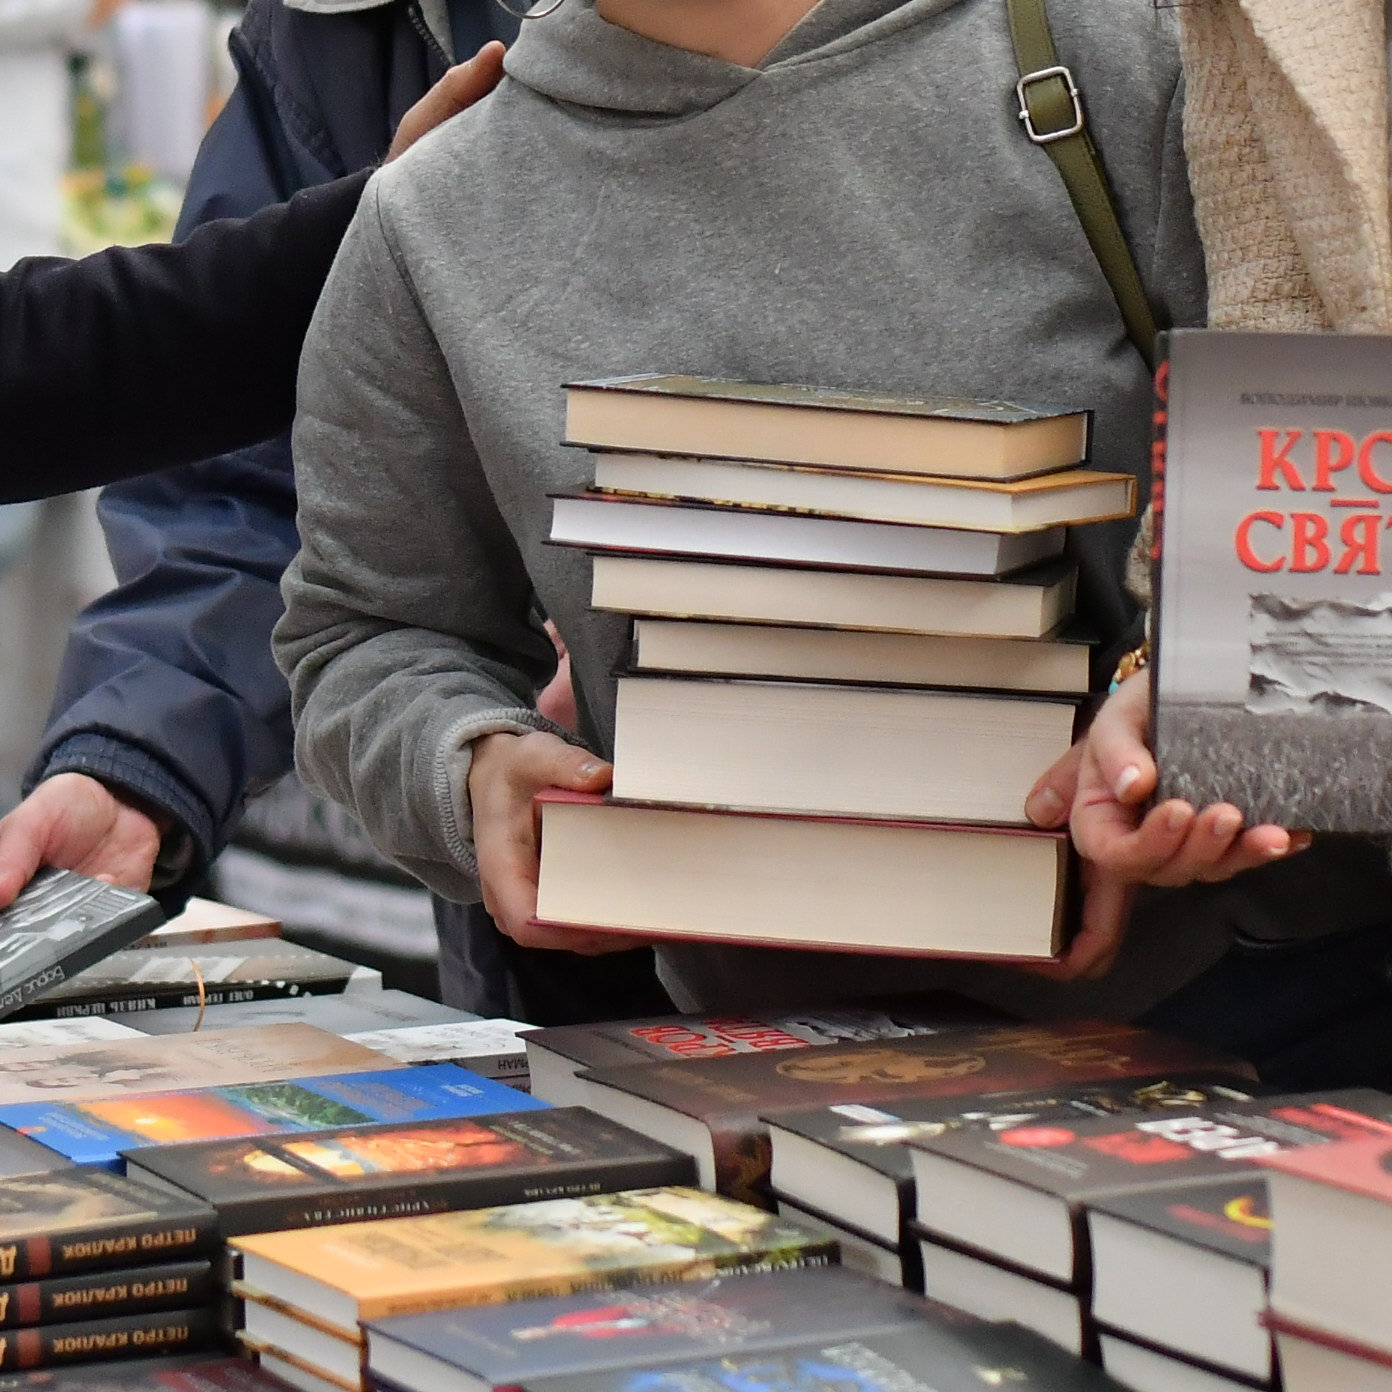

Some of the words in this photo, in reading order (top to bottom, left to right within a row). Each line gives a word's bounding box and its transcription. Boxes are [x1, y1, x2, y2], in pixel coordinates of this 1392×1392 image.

[112, 997, 157, 1013] КНЯЗЬ
[62, 1236, 137, 1259] КРАЛЮК
[141, 1227, 197, 1250] ПЕТРО
[52, 1284, 127, 1307] КРАЛЮК
[132, 1277, 188, 1299] ПЕТРО
[52, 1330, 128, 1354] КРАЛЮК
[132, 1325, 189, 1346] ПЕТРО
